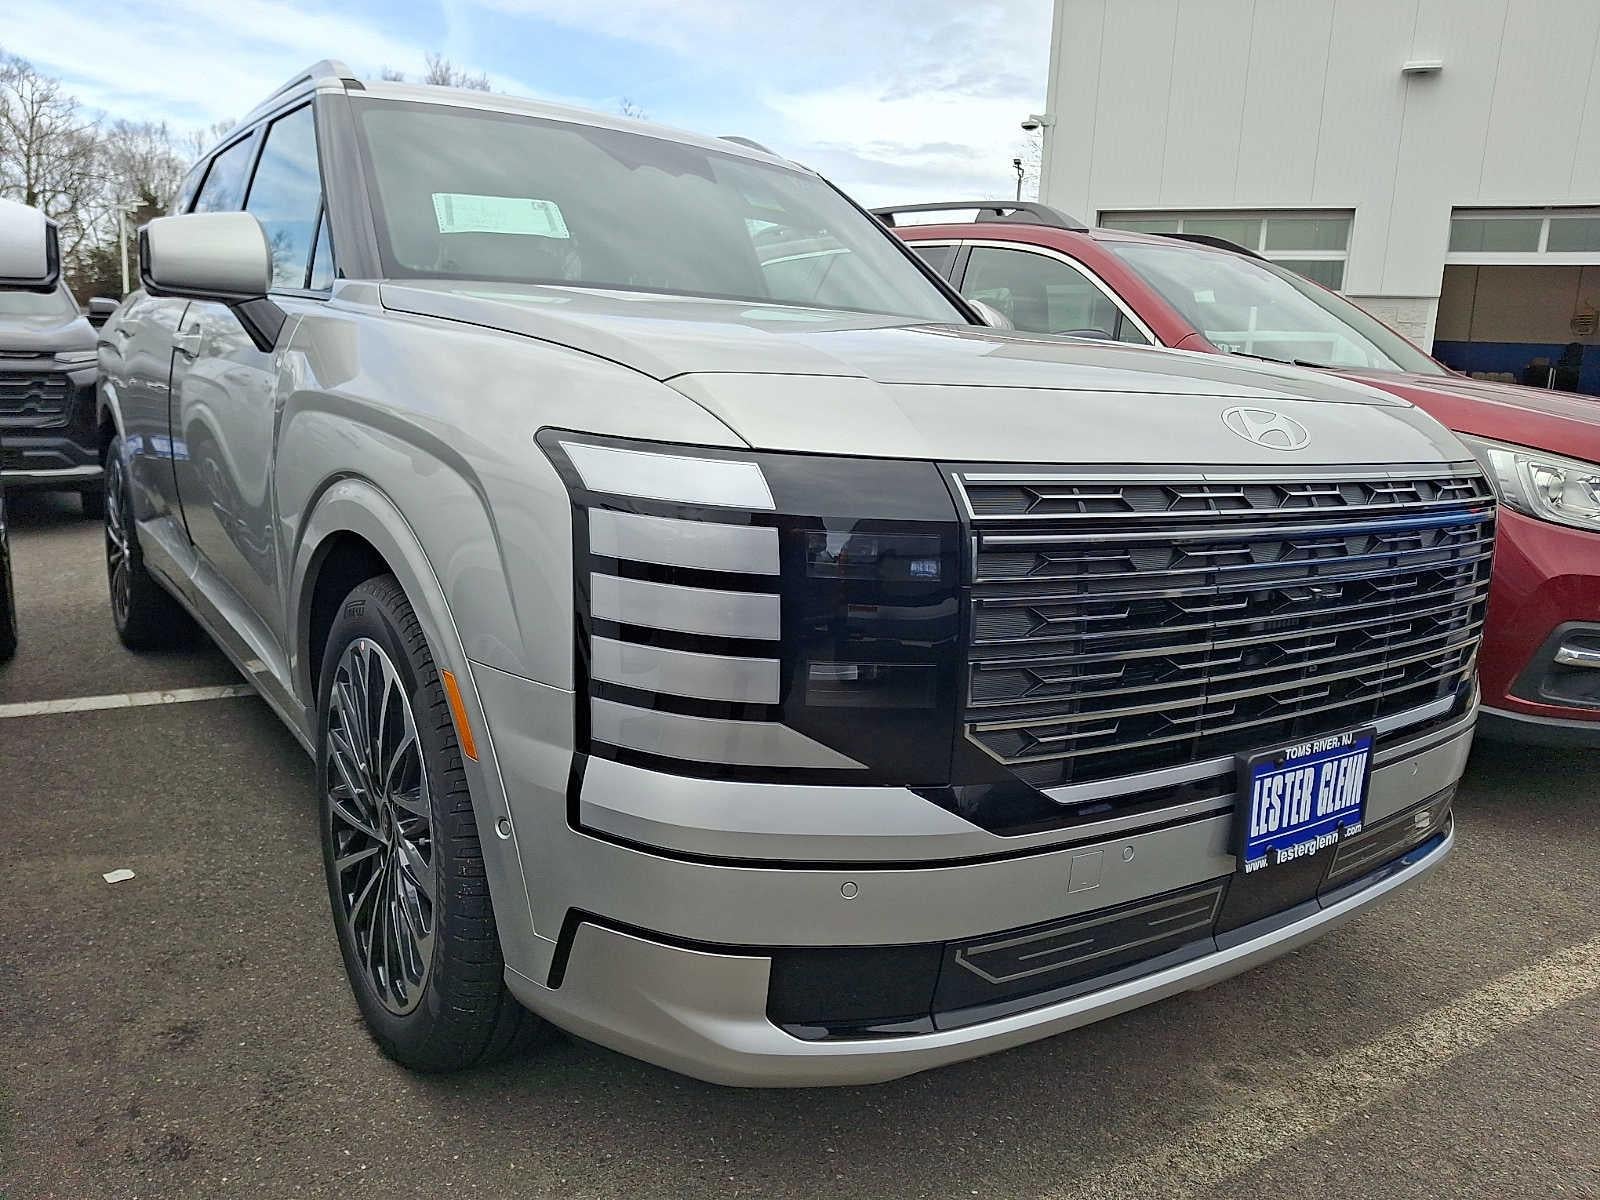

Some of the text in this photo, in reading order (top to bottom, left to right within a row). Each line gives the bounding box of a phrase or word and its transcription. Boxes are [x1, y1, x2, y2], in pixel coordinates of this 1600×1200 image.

[1285, 744, 1312, 760] TOMS
[1342, 733, 1353, 746] NJ
[1250, 752, 1368, 838] LESTER GLENN
[1245, 824, 1362, 873] www. lesterglenn .com
